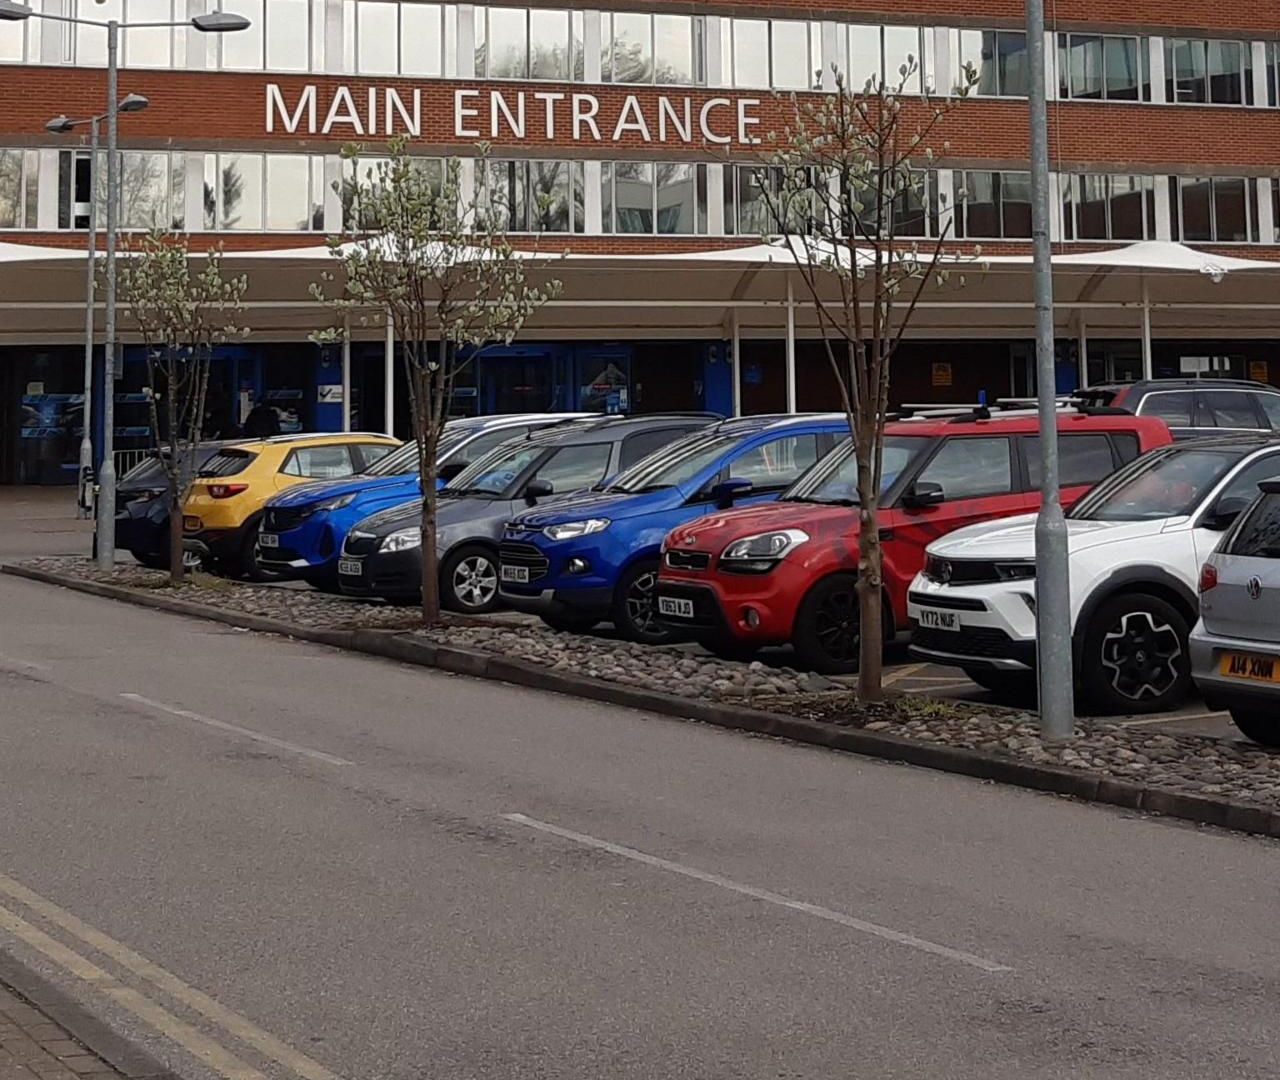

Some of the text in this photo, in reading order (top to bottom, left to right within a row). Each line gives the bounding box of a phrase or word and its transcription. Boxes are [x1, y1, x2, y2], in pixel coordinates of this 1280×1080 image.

[265, 83, 762, 145] MAIN ENTRANCE
[1228, 655, 1248, 675] A14
